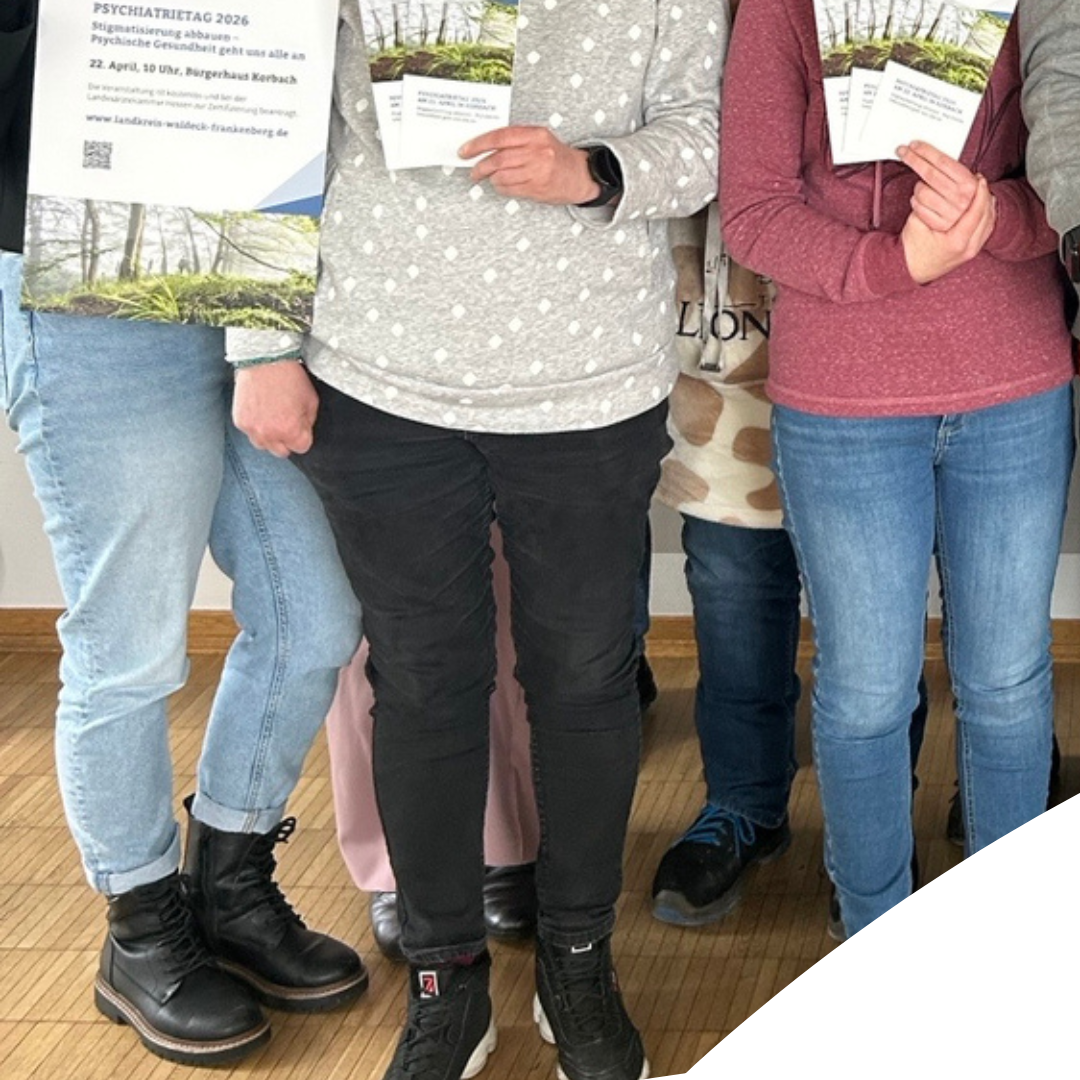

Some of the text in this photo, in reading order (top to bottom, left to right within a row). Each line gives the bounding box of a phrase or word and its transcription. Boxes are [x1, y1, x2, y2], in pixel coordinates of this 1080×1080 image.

[93, 2, 250, 27] PSYCHIATRIETAG 2026
[91, 21, 182, 40] Stigmatisierung
[184, 29, 231, 42] abbauen
[90, 34, 306, 61] Psychische Gesundheit geht uns alle an
[90, 59, 298, 85] 22. April, 10 Uhr, Bürgerhaus Korbach
[86, 115, 290, 139] www.landkreis-waldeck-frankenberg.de
